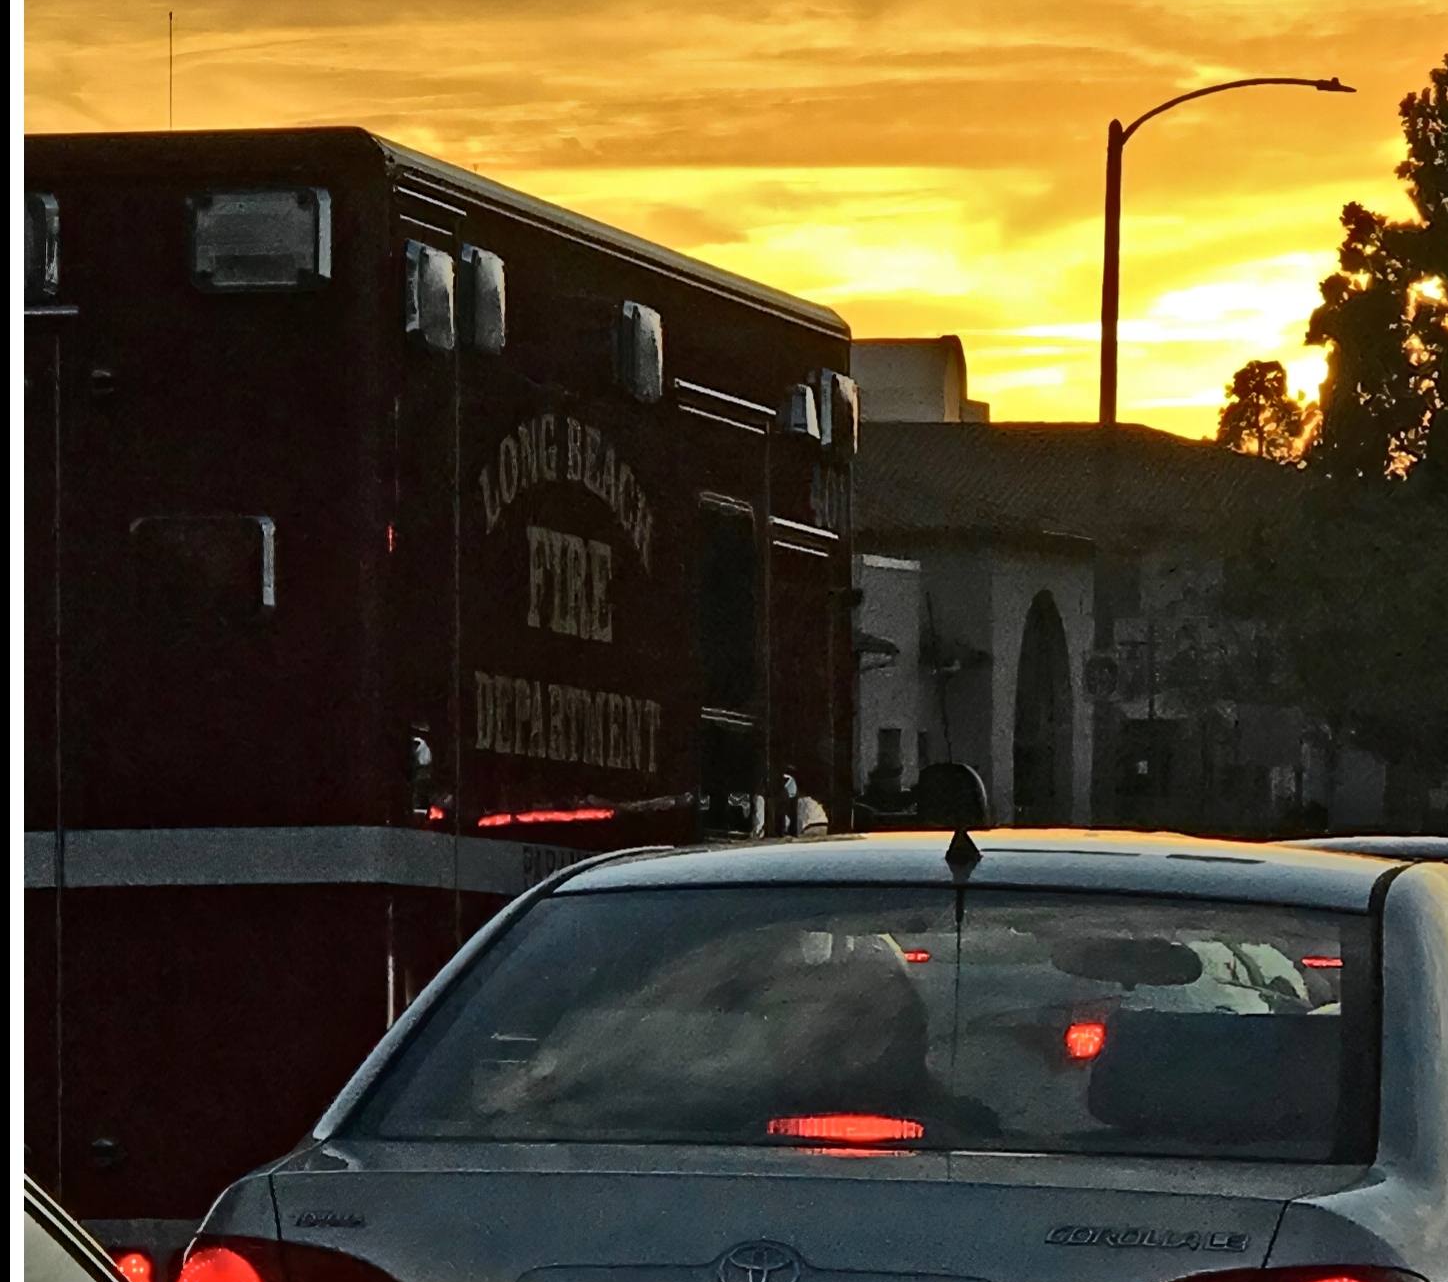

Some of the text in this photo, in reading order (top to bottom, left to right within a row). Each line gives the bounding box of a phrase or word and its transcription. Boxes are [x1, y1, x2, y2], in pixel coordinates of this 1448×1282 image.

[479, 413, 655, 576] LONG BEACH
[526, 523, 614, 643] FIRE
[475, 670, 661, 773] DEPARTMENT
[1044, 1225, 1250, 1252] COROLLA LE
